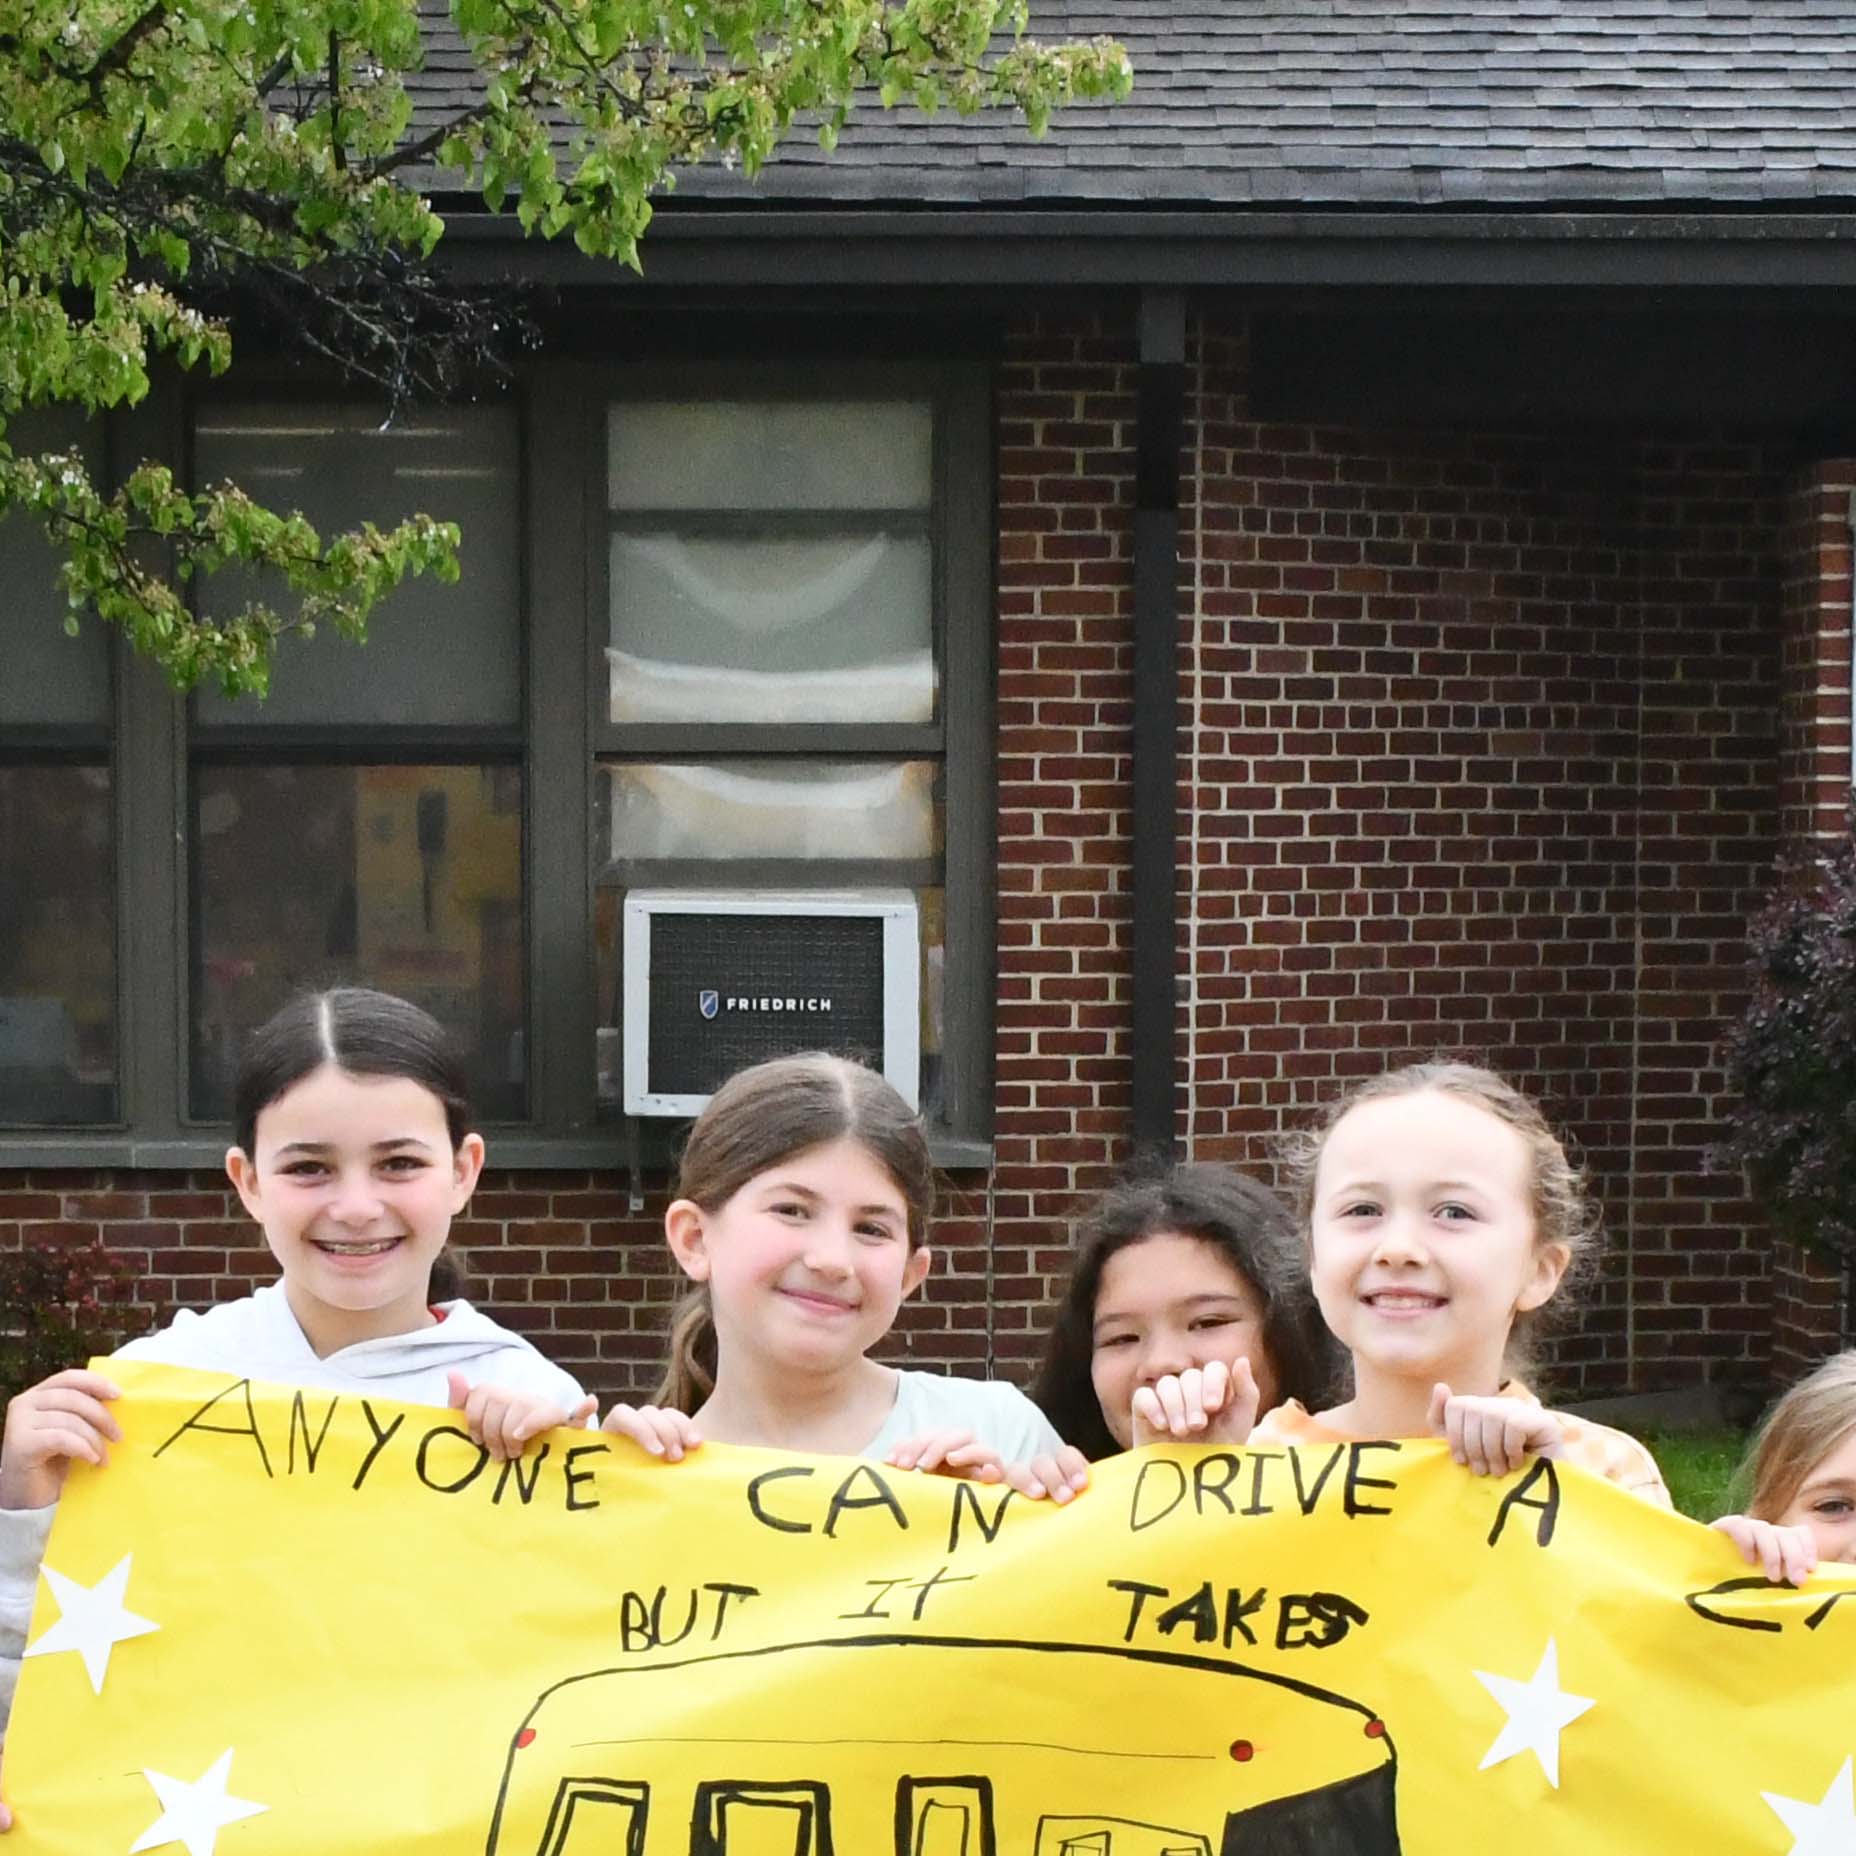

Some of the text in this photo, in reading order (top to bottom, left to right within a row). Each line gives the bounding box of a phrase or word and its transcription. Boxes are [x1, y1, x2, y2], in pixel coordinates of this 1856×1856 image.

[726, 997, 832, 1013] FRIEDRICH
[152, 1378, 613, 1511] ANYONE
[746, 1464, 1015, 1553] CAN
[1129, 1439, 1402, 1532] DRIVE
[1486, 1456, 1562, 1548] A
[619, 1582, 760, 1653] BUT
[1107, 1579, 1370, 1650] TAKES
